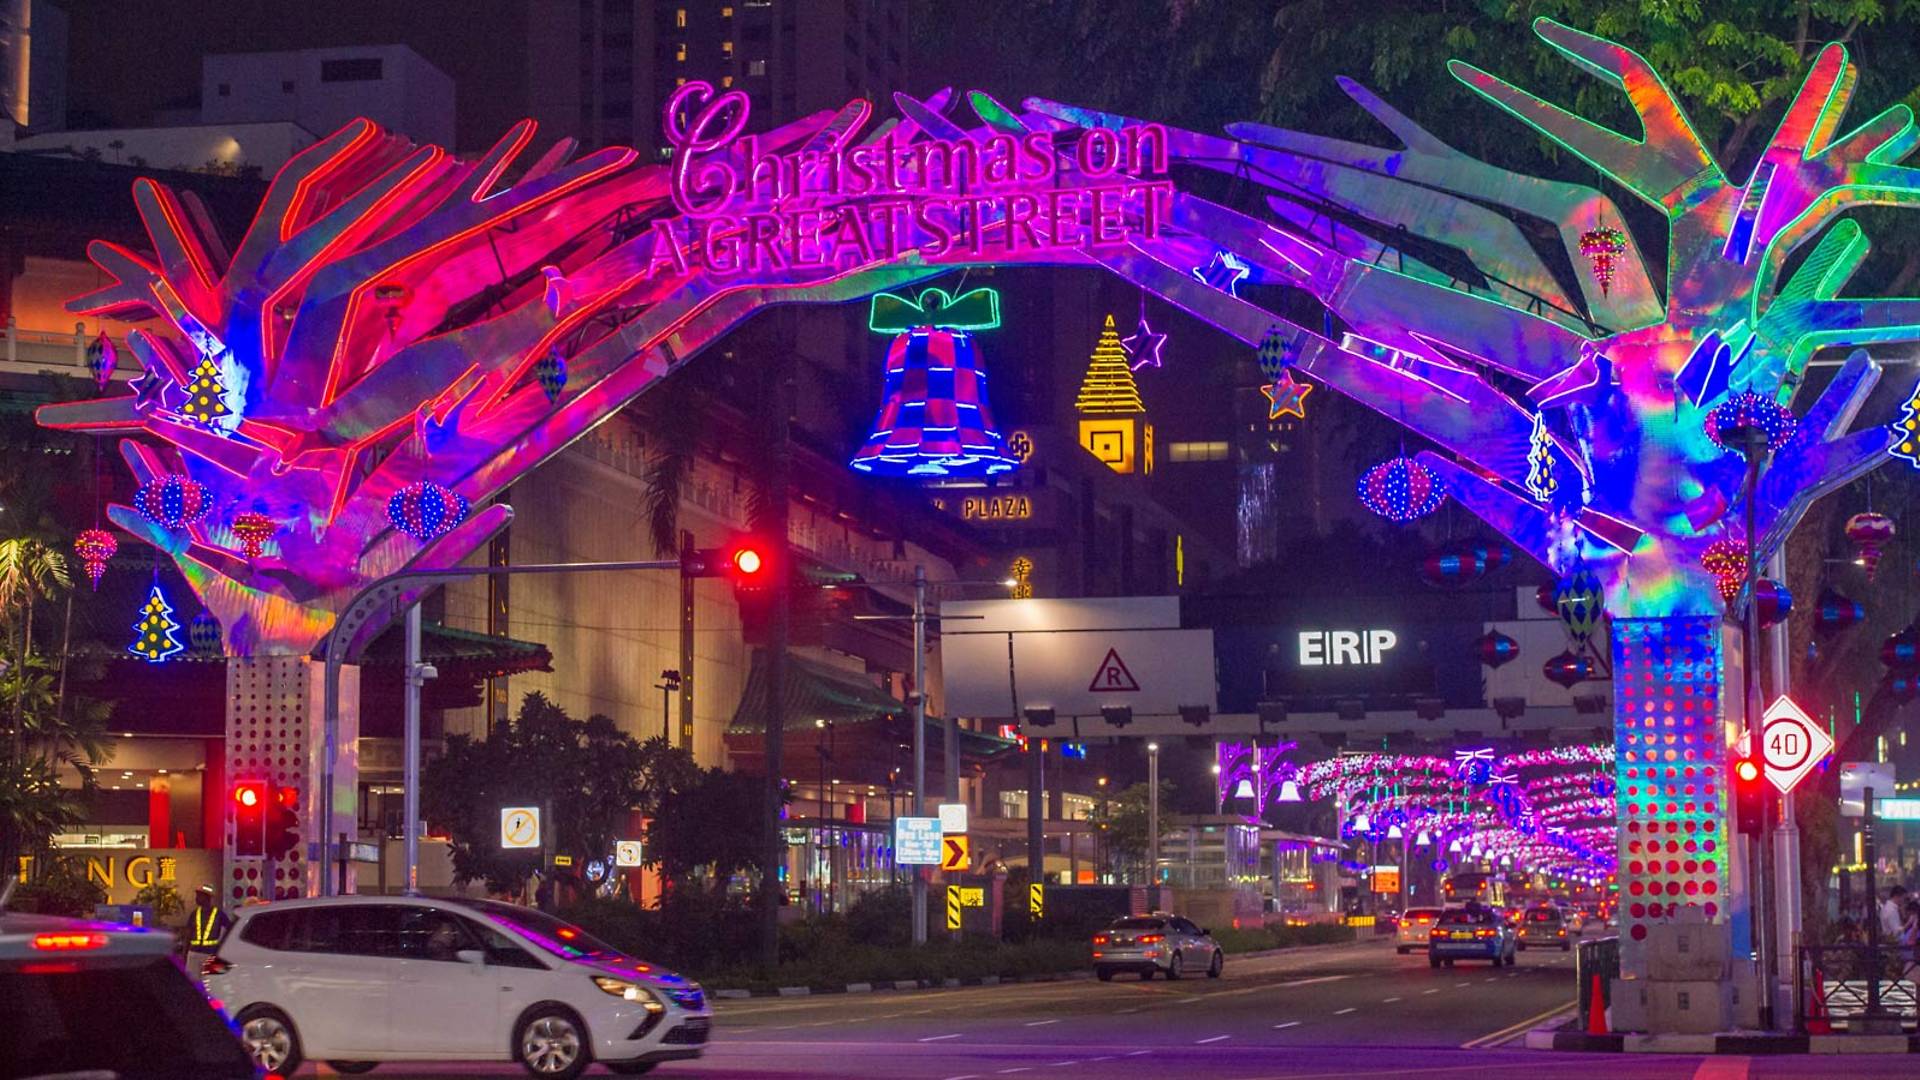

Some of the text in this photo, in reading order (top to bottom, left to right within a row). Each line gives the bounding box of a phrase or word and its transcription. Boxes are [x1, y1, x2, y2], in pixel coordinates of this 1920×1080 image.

[663, 81, 1169, 217] Christmas on
[643, 180, 1174, 281] A GREAT STREET
[964, 497, 1030, 518] PLAZA
[1299, 630, 1396, 666] ERP
[1106, 667, 1121, 686] R
[1771, 733, 1798, 755] 40
[18, 856, 153, 889] TNG
